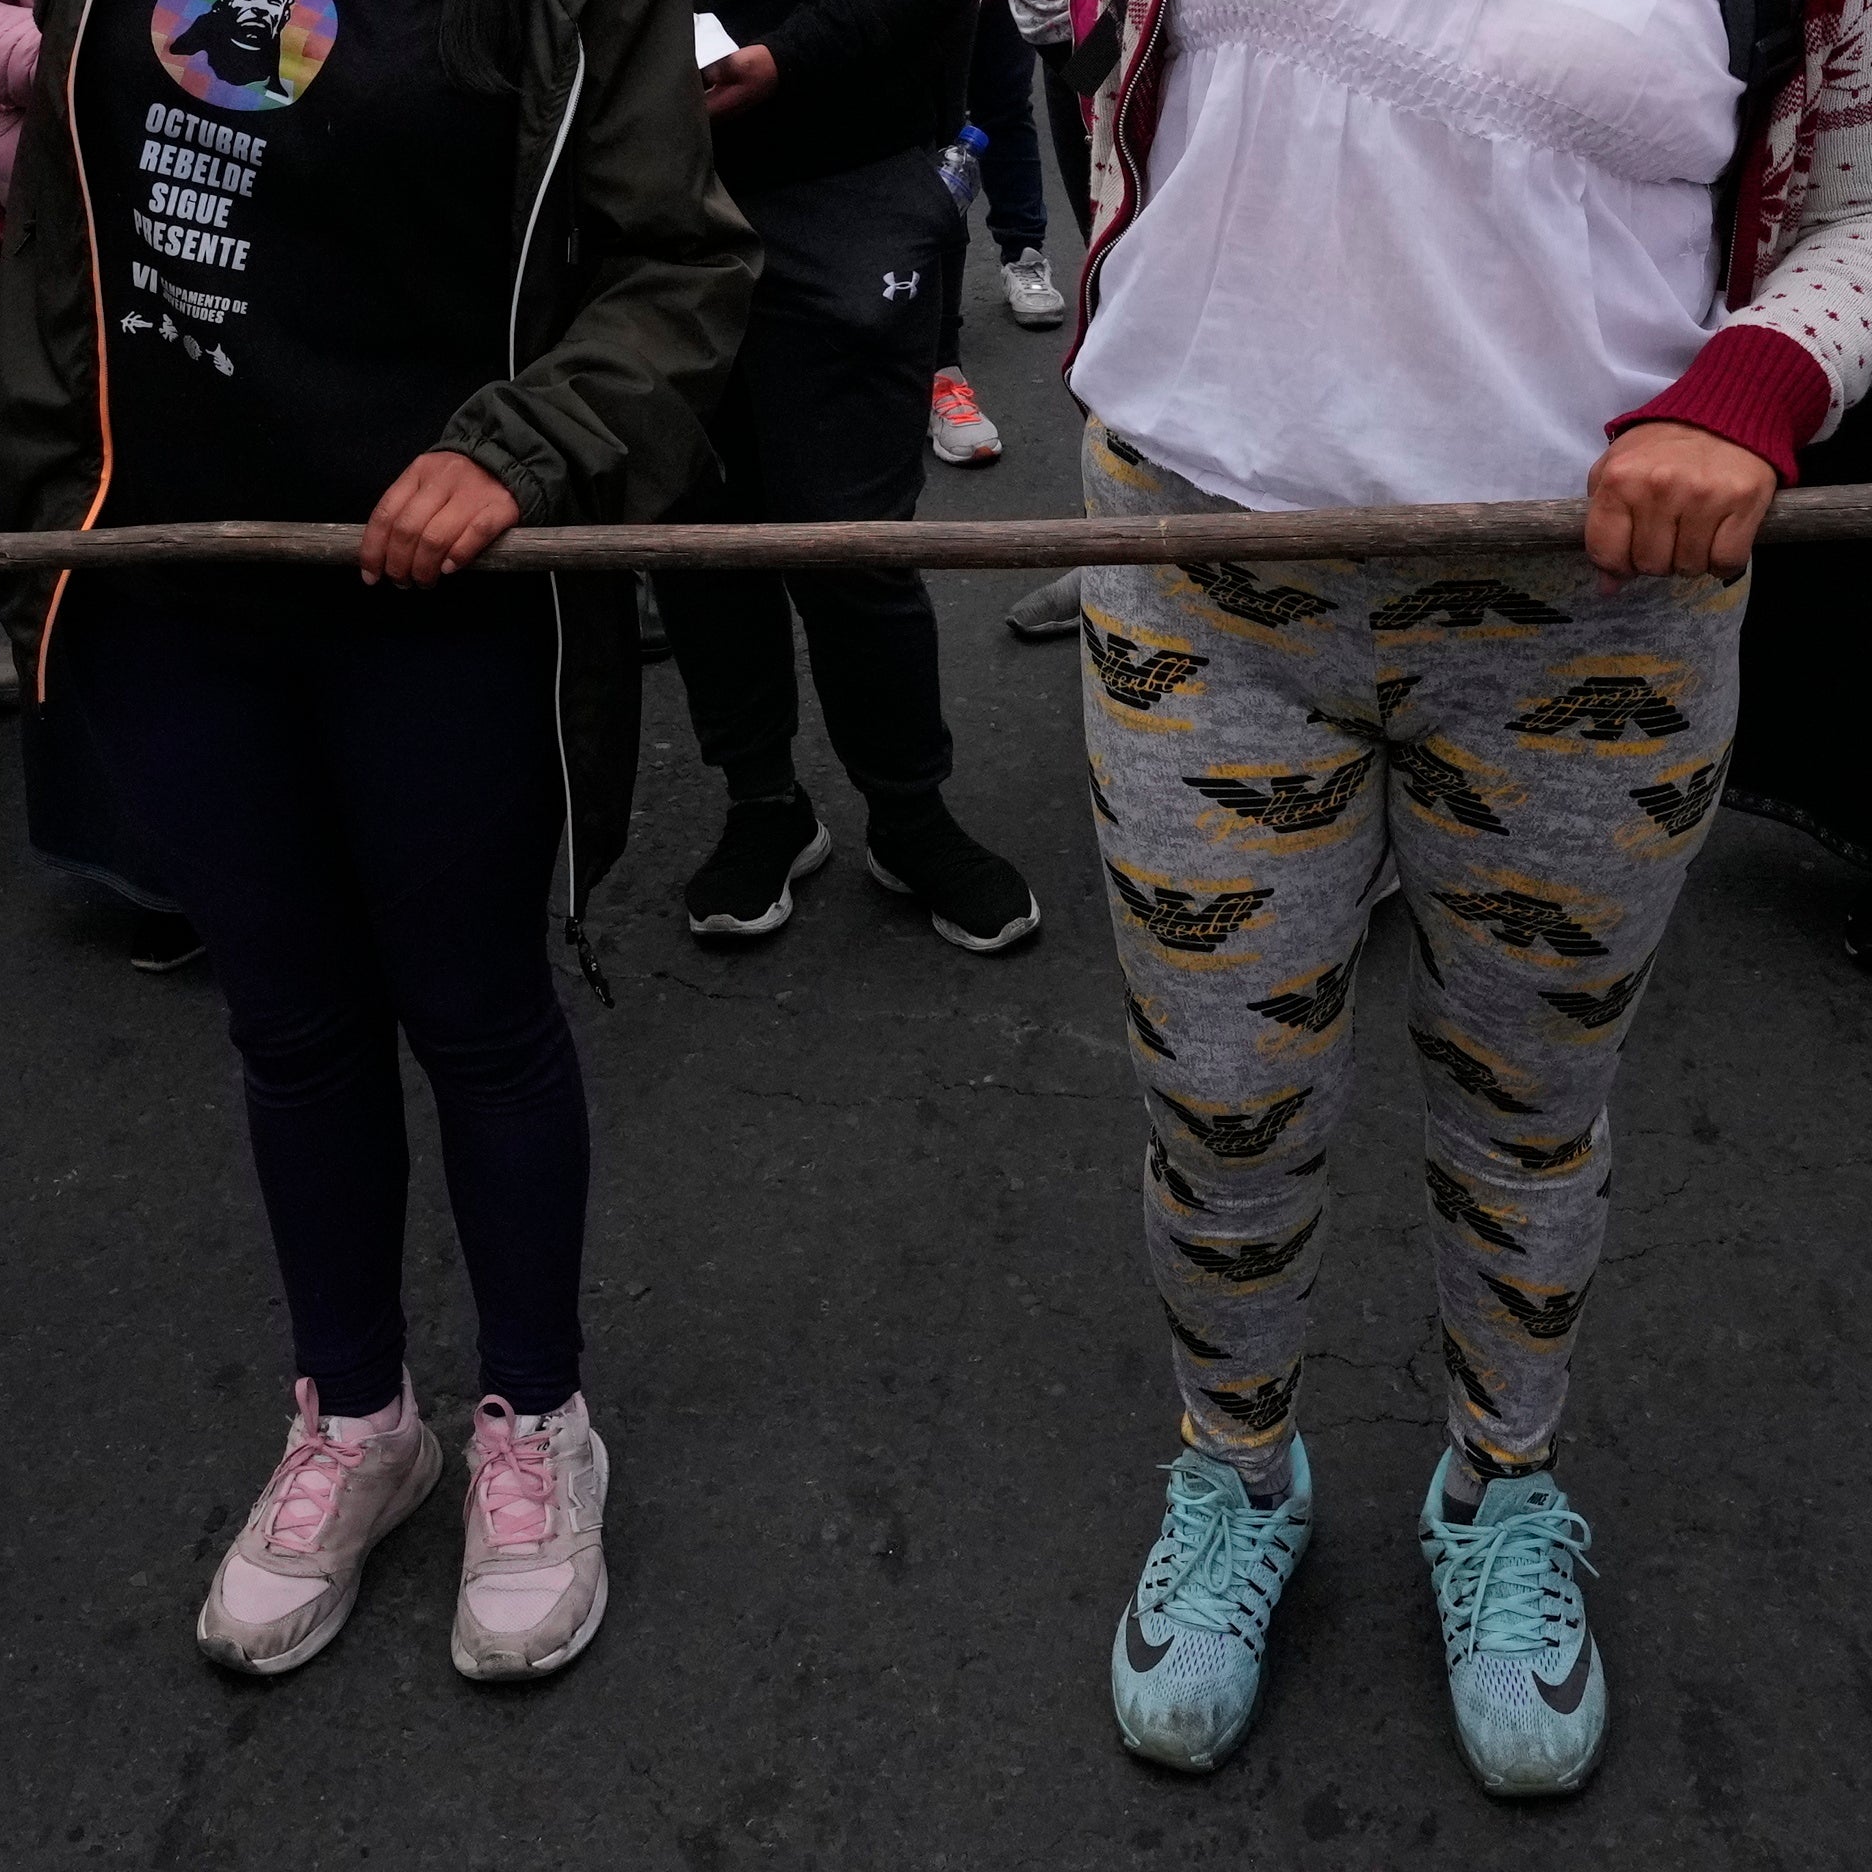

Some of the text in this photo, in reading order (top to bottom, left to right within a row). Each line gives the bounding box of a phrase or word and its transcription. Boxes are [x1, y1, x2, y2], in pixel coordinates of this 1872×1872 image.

[145, 102, 267, 167] OCTUBRE
[139, 139, 257, 198] REBELDE
[148, 181, 233, 229] SIGUE
[133, 208, 251, 271] PRESENTE
[132, 261, 158, 294] VI
[232, 299, 248, 315] DE
[1527, 1491, 1549, 1506] NIKE
